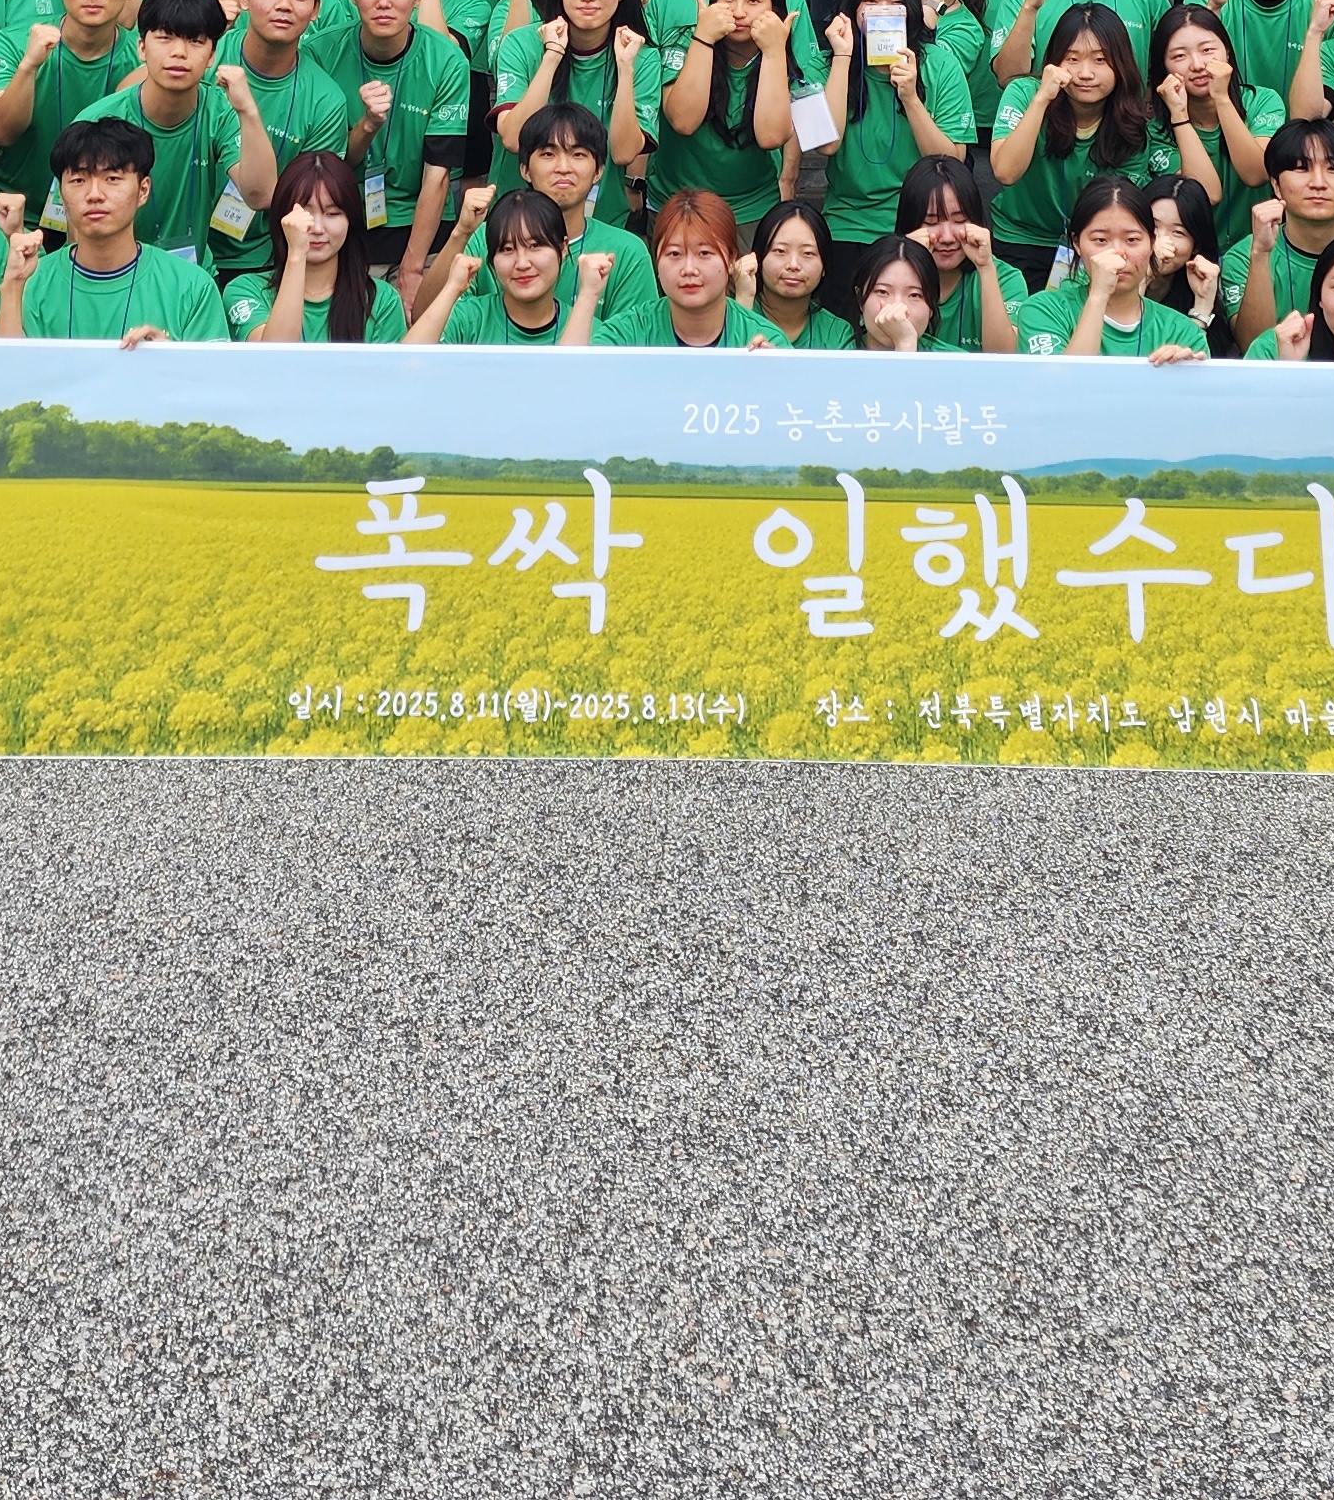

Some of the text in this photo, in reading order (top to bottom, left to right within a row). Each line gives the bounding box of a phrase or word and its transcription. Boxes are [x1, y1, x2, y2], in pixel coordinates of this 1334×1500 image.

[682, 399, 1009, 446] 2025 농촌봉사활동
[314, 468, 644, 634] 폭싹
[287, 684, 342, 721] 일시
[815, 689, 870, 728] 장소
[917, 690, 1147, 733] 전북특별자치도
[1168, 695, 1262, 736] 남원시
